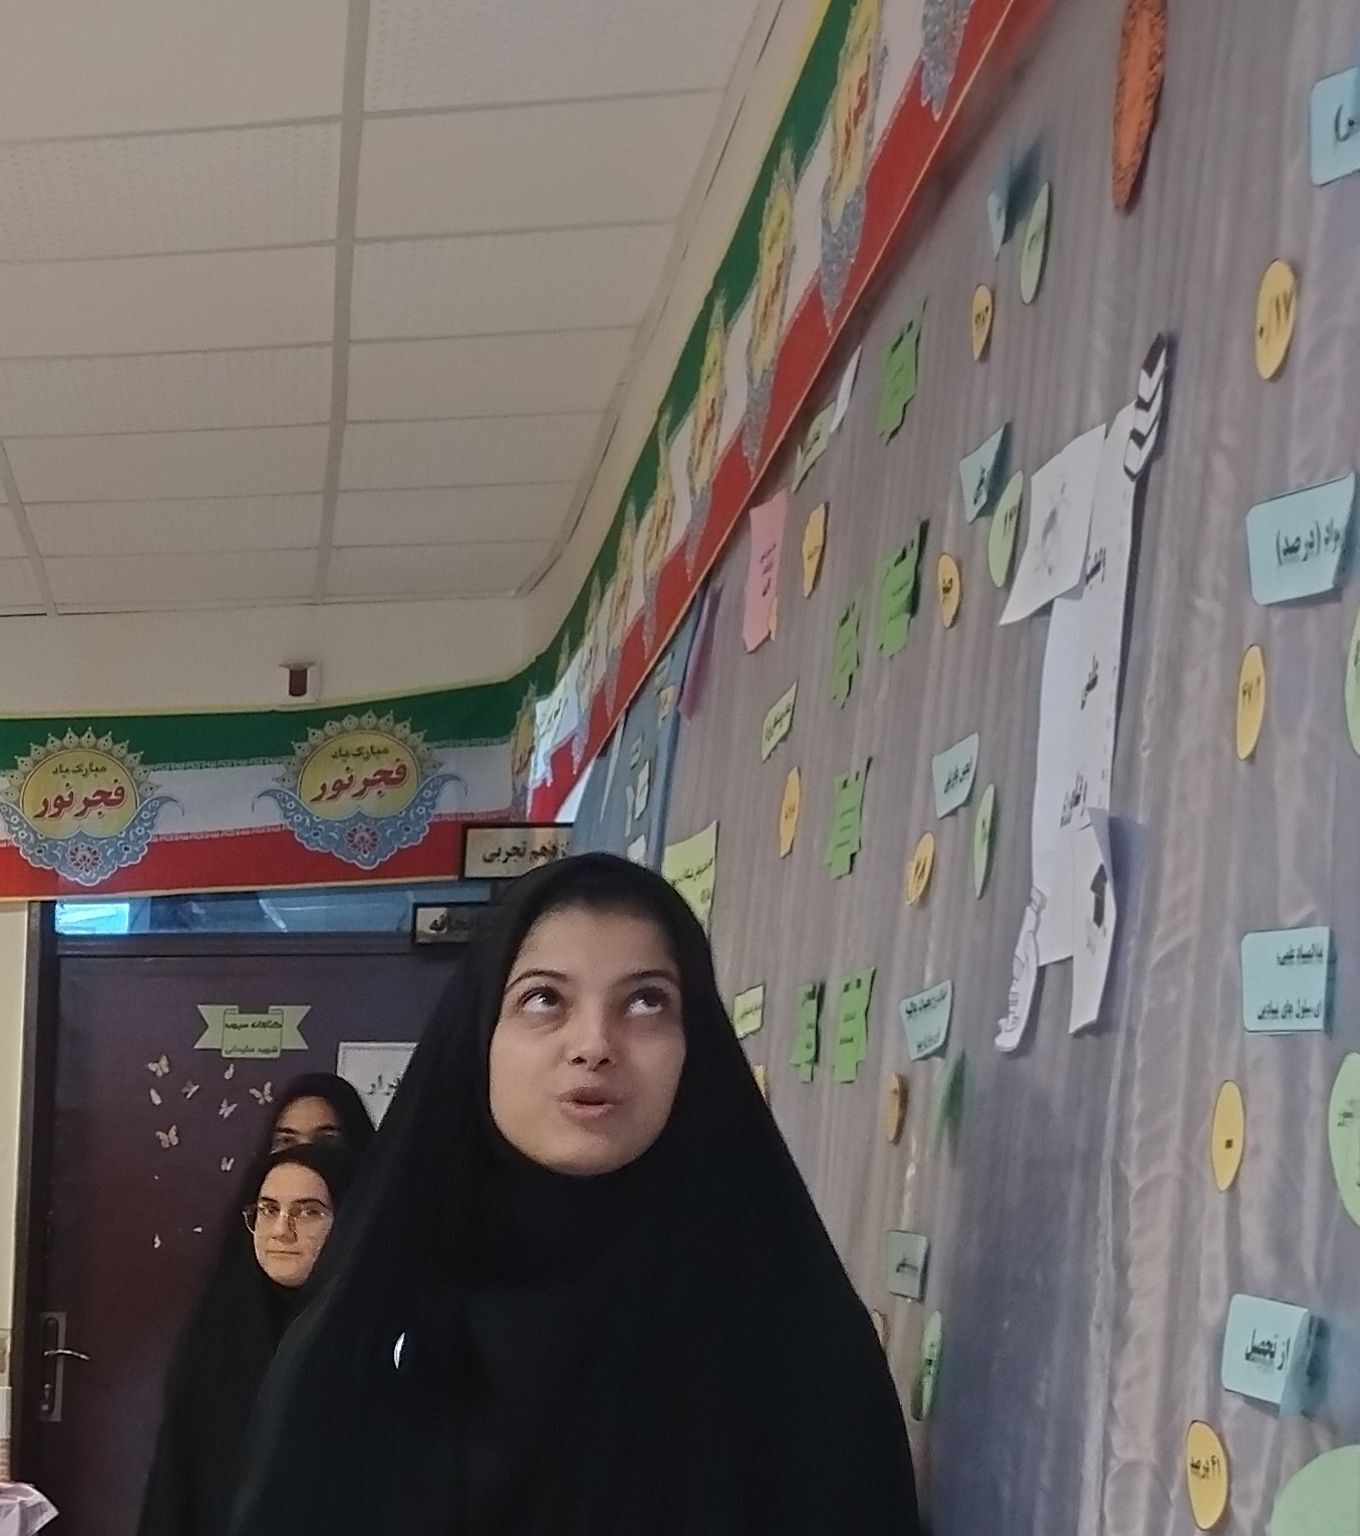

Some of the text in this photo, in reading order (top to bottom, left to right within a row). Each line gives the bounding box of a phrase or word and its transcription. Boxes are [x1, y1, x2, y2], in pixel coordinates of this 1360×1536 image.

[33, 778, 126, 818] فجر نور
[310, 758, 407, 802] فجر نور
[482, 841, 528, 864] تجربی
